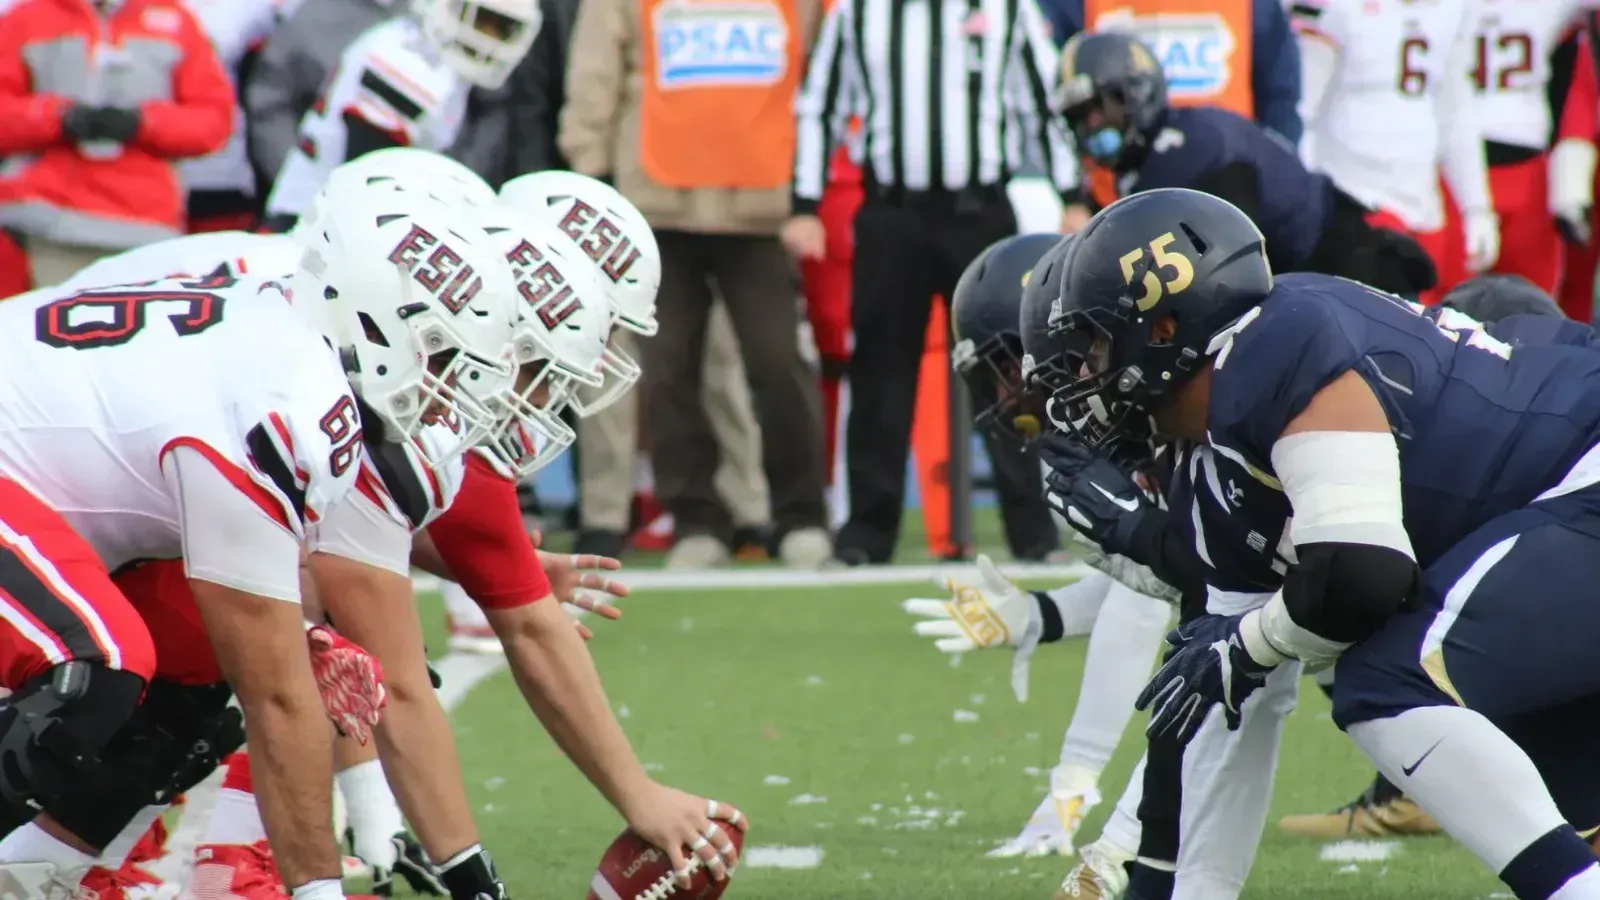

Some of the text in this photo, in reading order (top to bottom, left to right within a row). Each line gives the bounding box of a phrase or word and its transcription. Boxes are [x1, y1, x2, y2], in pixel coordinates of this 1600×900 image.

[660, 25, 782, 61] PSAC
[1150, 40, 1220, 77] AC
[1399, 37, 1428, 97] 6
[1466, 32, 1534, 93] 12
[387, 222, 483, 316] ESU
[558, 198, 642, 284] ESU
[1119, 231, 1194, 312] 55
[505, 238, 584, 332] ESU
[319, 394, 363, 478] 66
